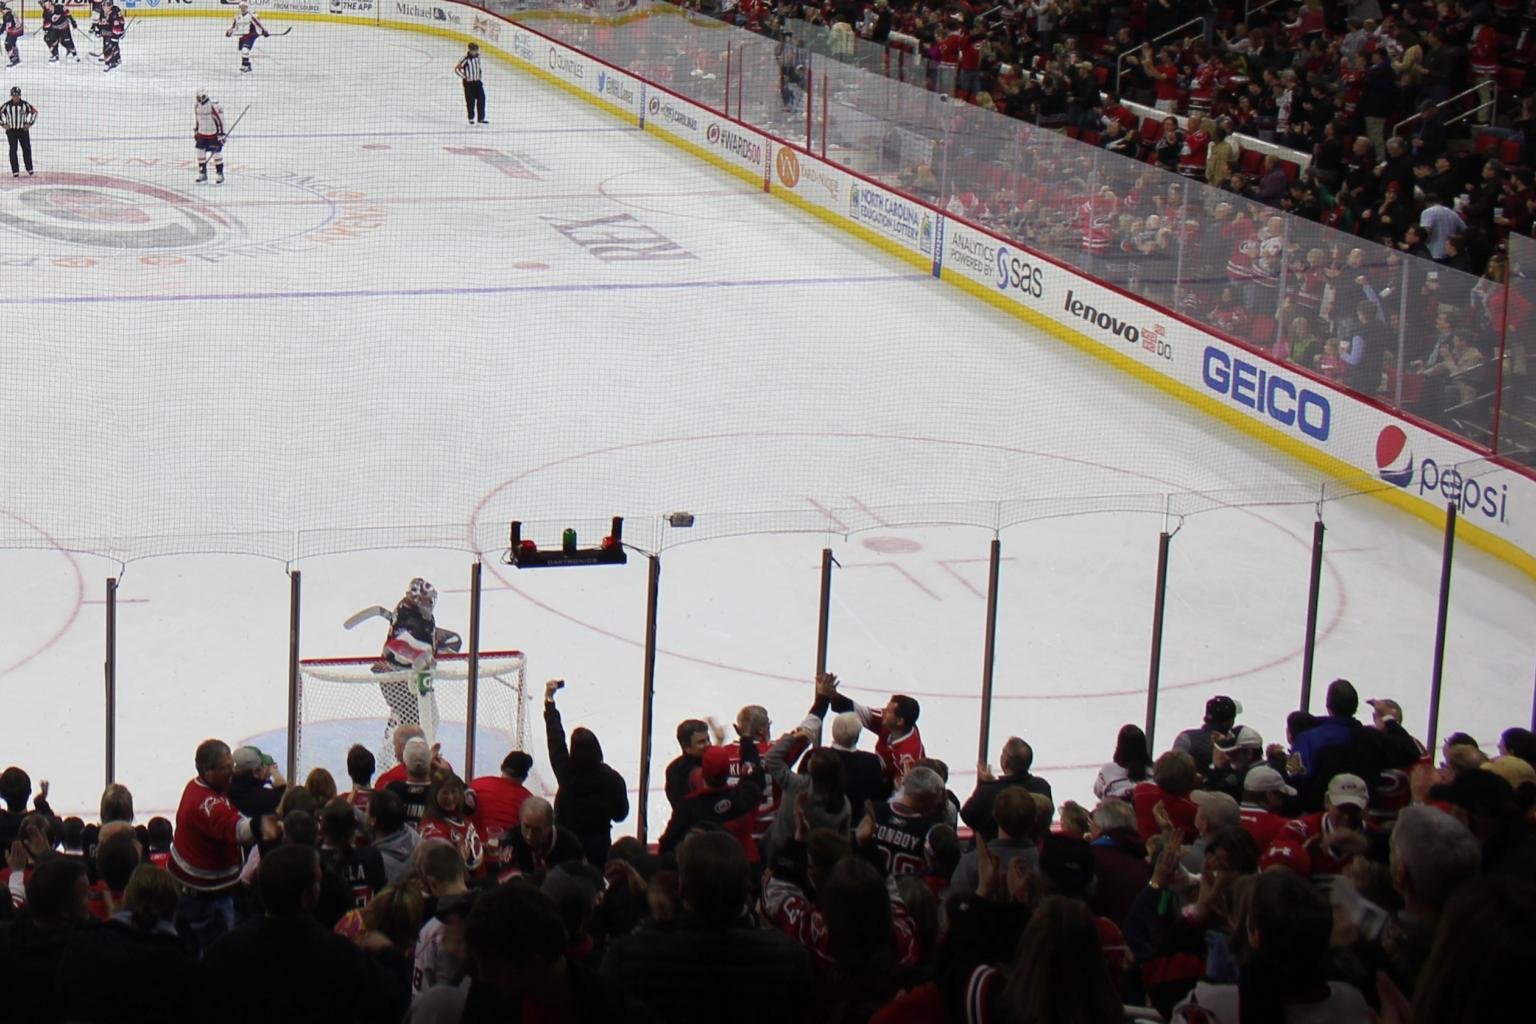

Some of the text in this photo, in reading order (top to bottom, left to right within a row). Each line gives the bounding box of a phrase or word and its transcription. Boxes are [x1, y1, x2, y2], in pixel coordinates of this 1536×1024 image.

[342, 2, 357, 10] THE
[396, 1, 433, 20] Michael
[720, 128, 762, 166] #WARD500
[860, 189, 919, 226] NORTH CAROLINA
[860, 205, 919, 240] EDUCATION LOTTERY
[950, 247, 994, 278] POWERED BY
[952, 232, 995, 263] ANALYTICS
[1010, 257, 1043, 298] sas
[1063, 289, 1140, 344] lenovo
[1202, 345, 1331, 442] GEICO
[1419, 457, 1509, 524] pepsi
